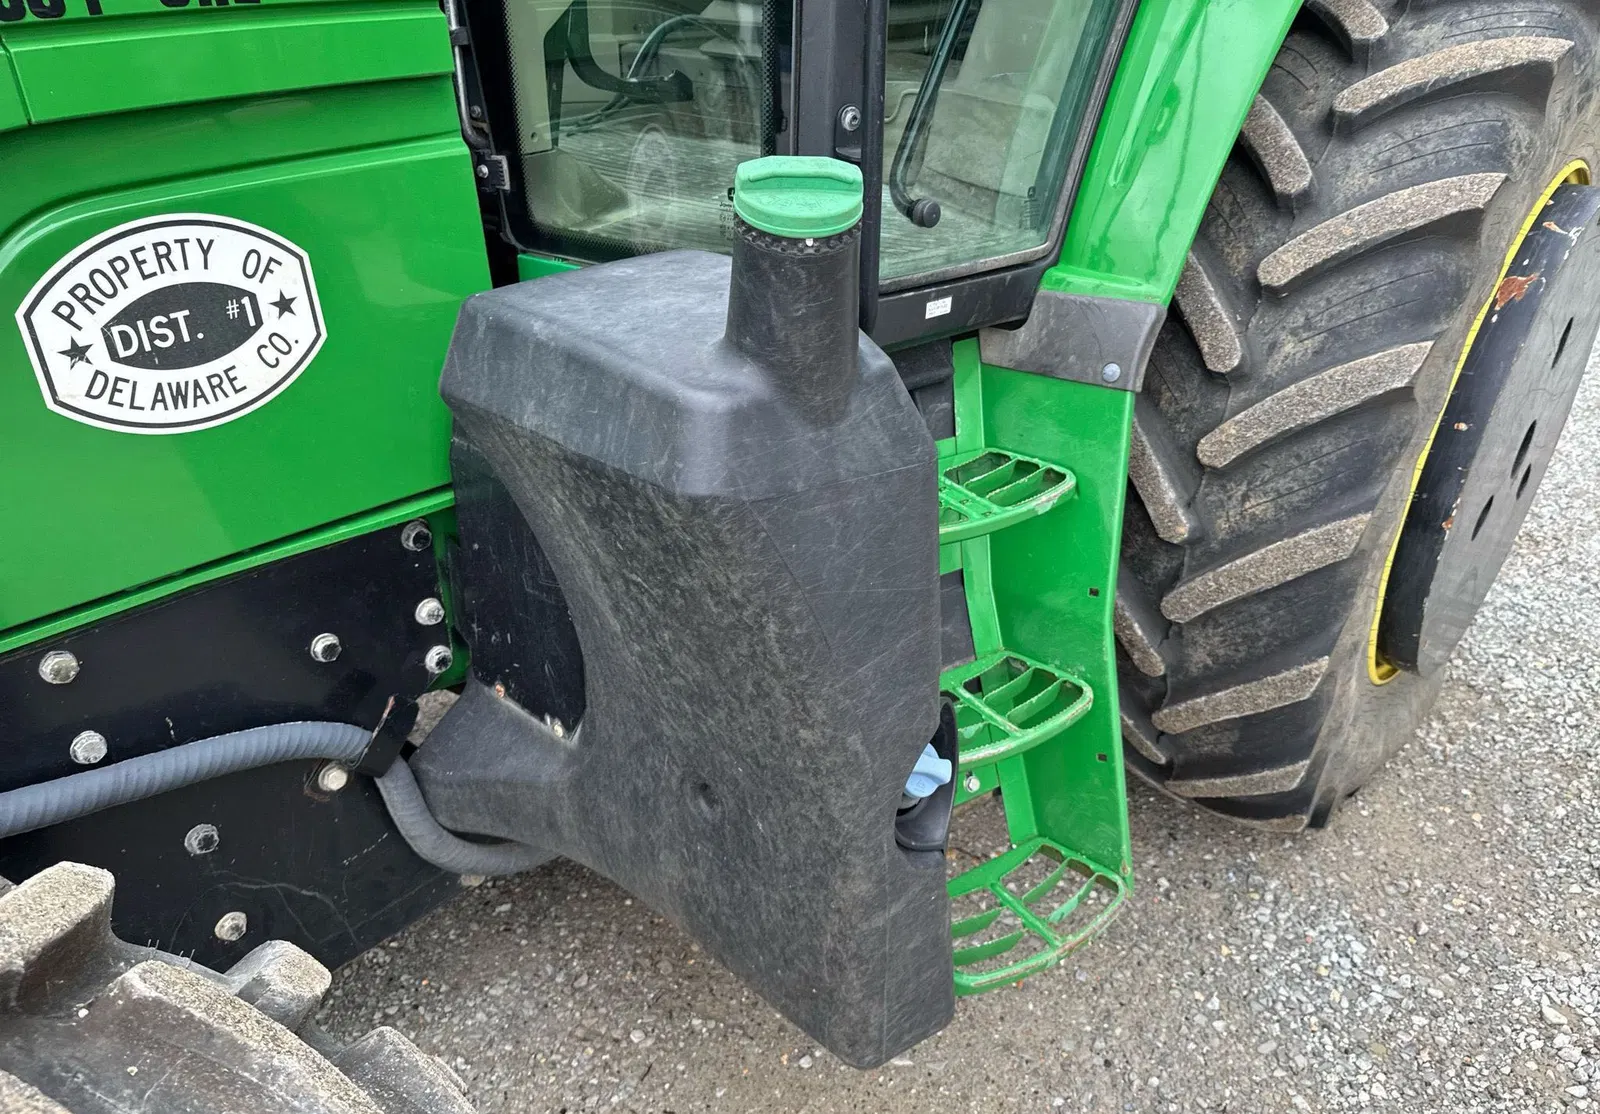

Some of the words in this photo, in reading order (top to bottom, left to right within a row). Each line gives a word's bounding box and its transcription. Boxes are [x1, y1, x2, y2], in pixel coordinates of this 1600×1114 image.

[51, 238, 215, 332] PROPERTY
[242, 248, 283, 284] OF
[109, 309, 205, 358] DIST.
[226, 296, 257, 327] #1
[84, 365, 247, 412] DELAWARE
[256, 332, 300, 369] CO.
